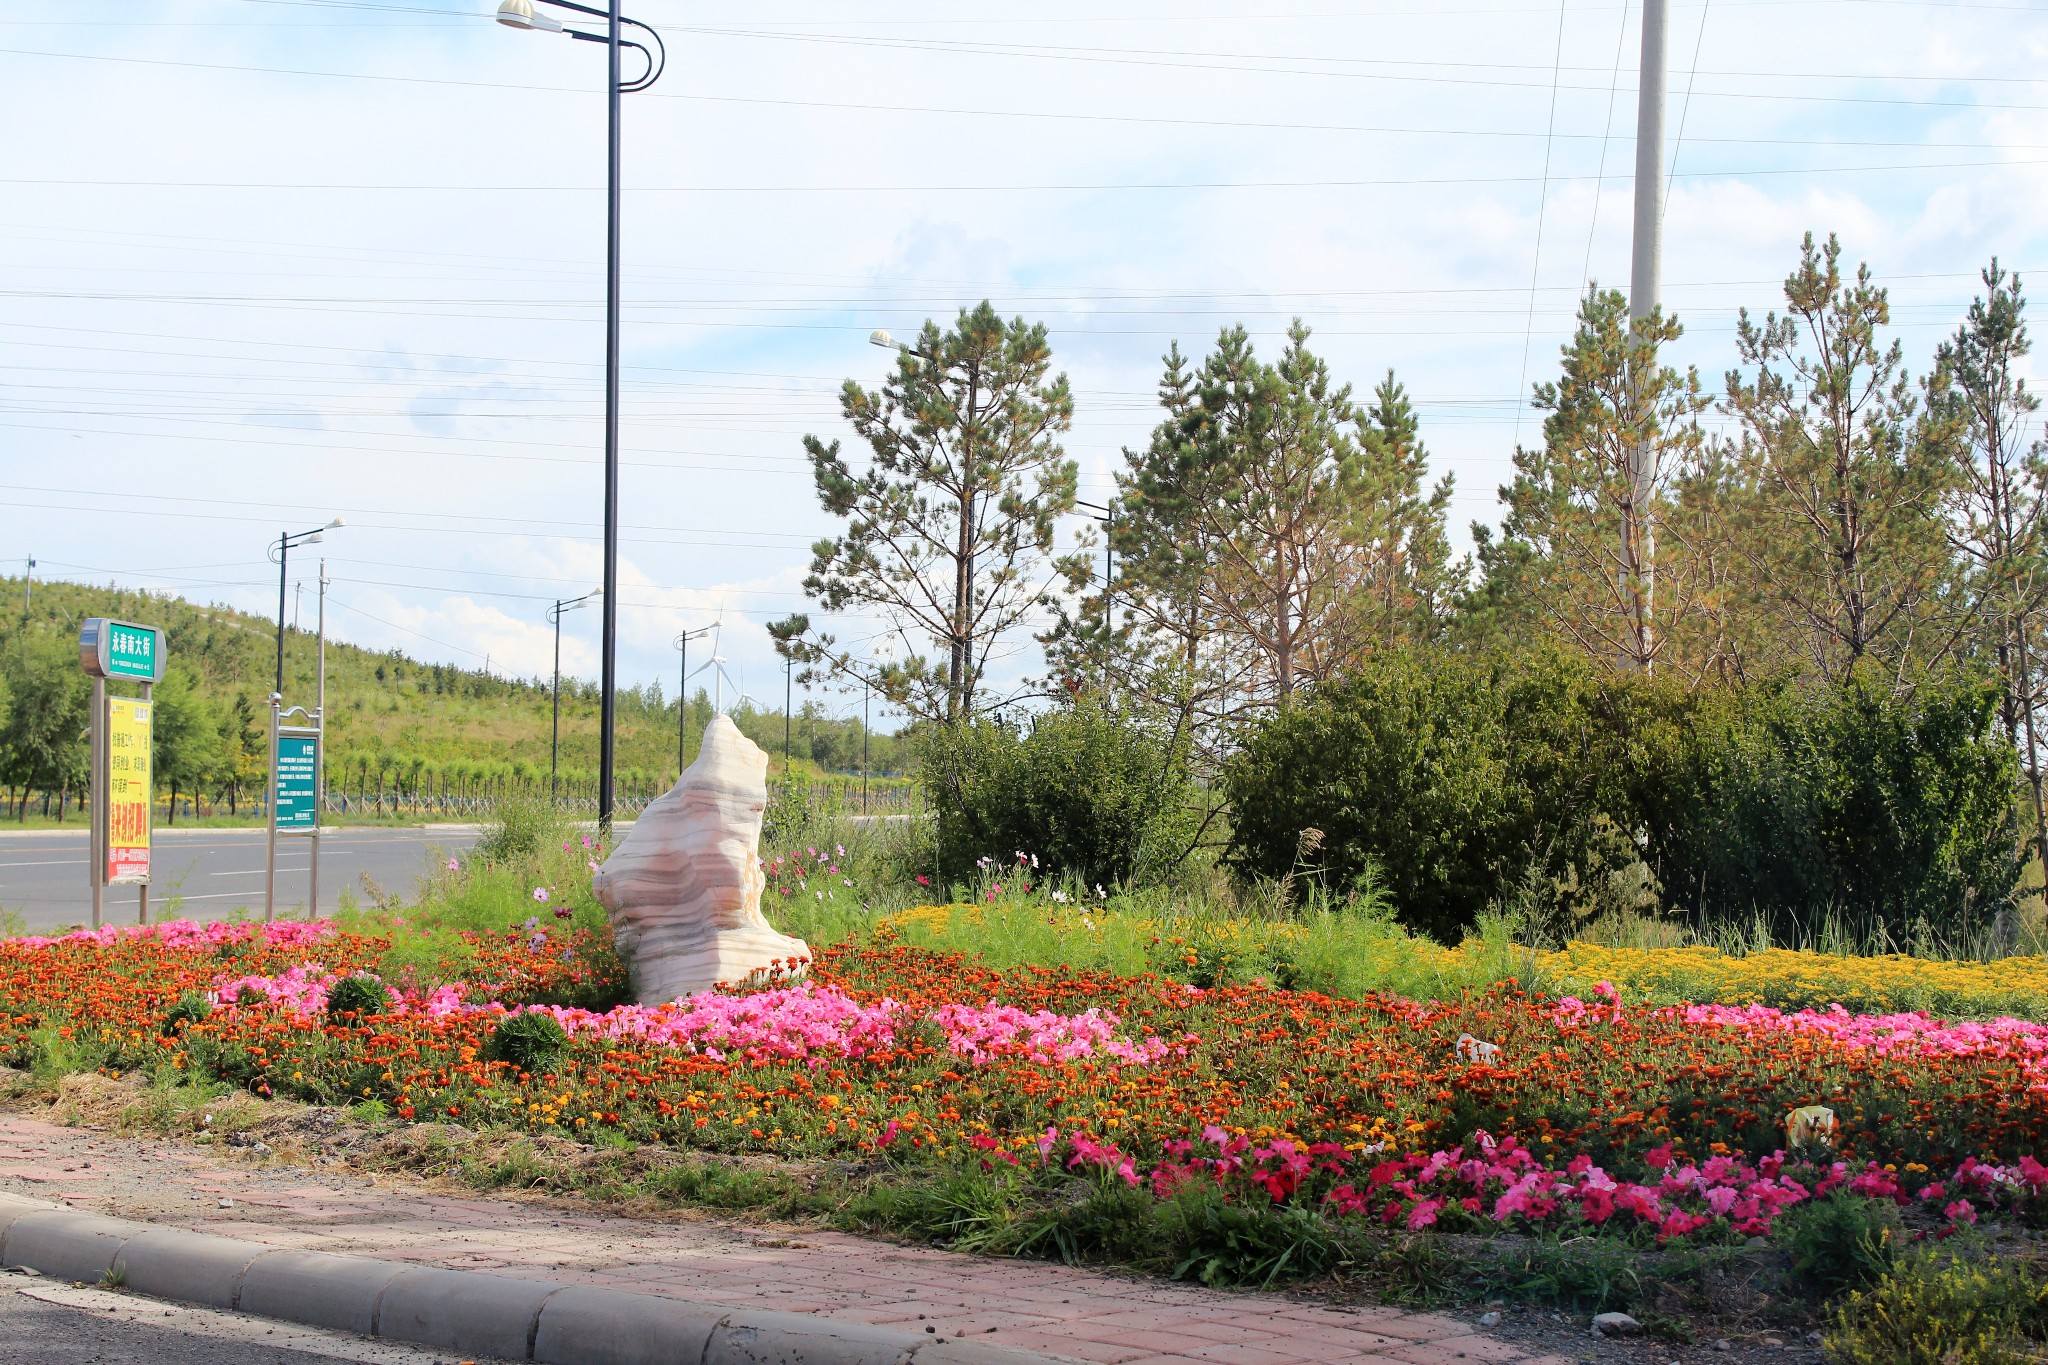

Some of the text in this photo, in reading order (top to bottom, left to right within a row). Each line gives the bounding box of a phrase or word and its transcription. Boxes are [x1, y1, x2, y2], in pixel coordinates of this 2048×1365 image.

[112, 631, 150, 657] 永春南大街
